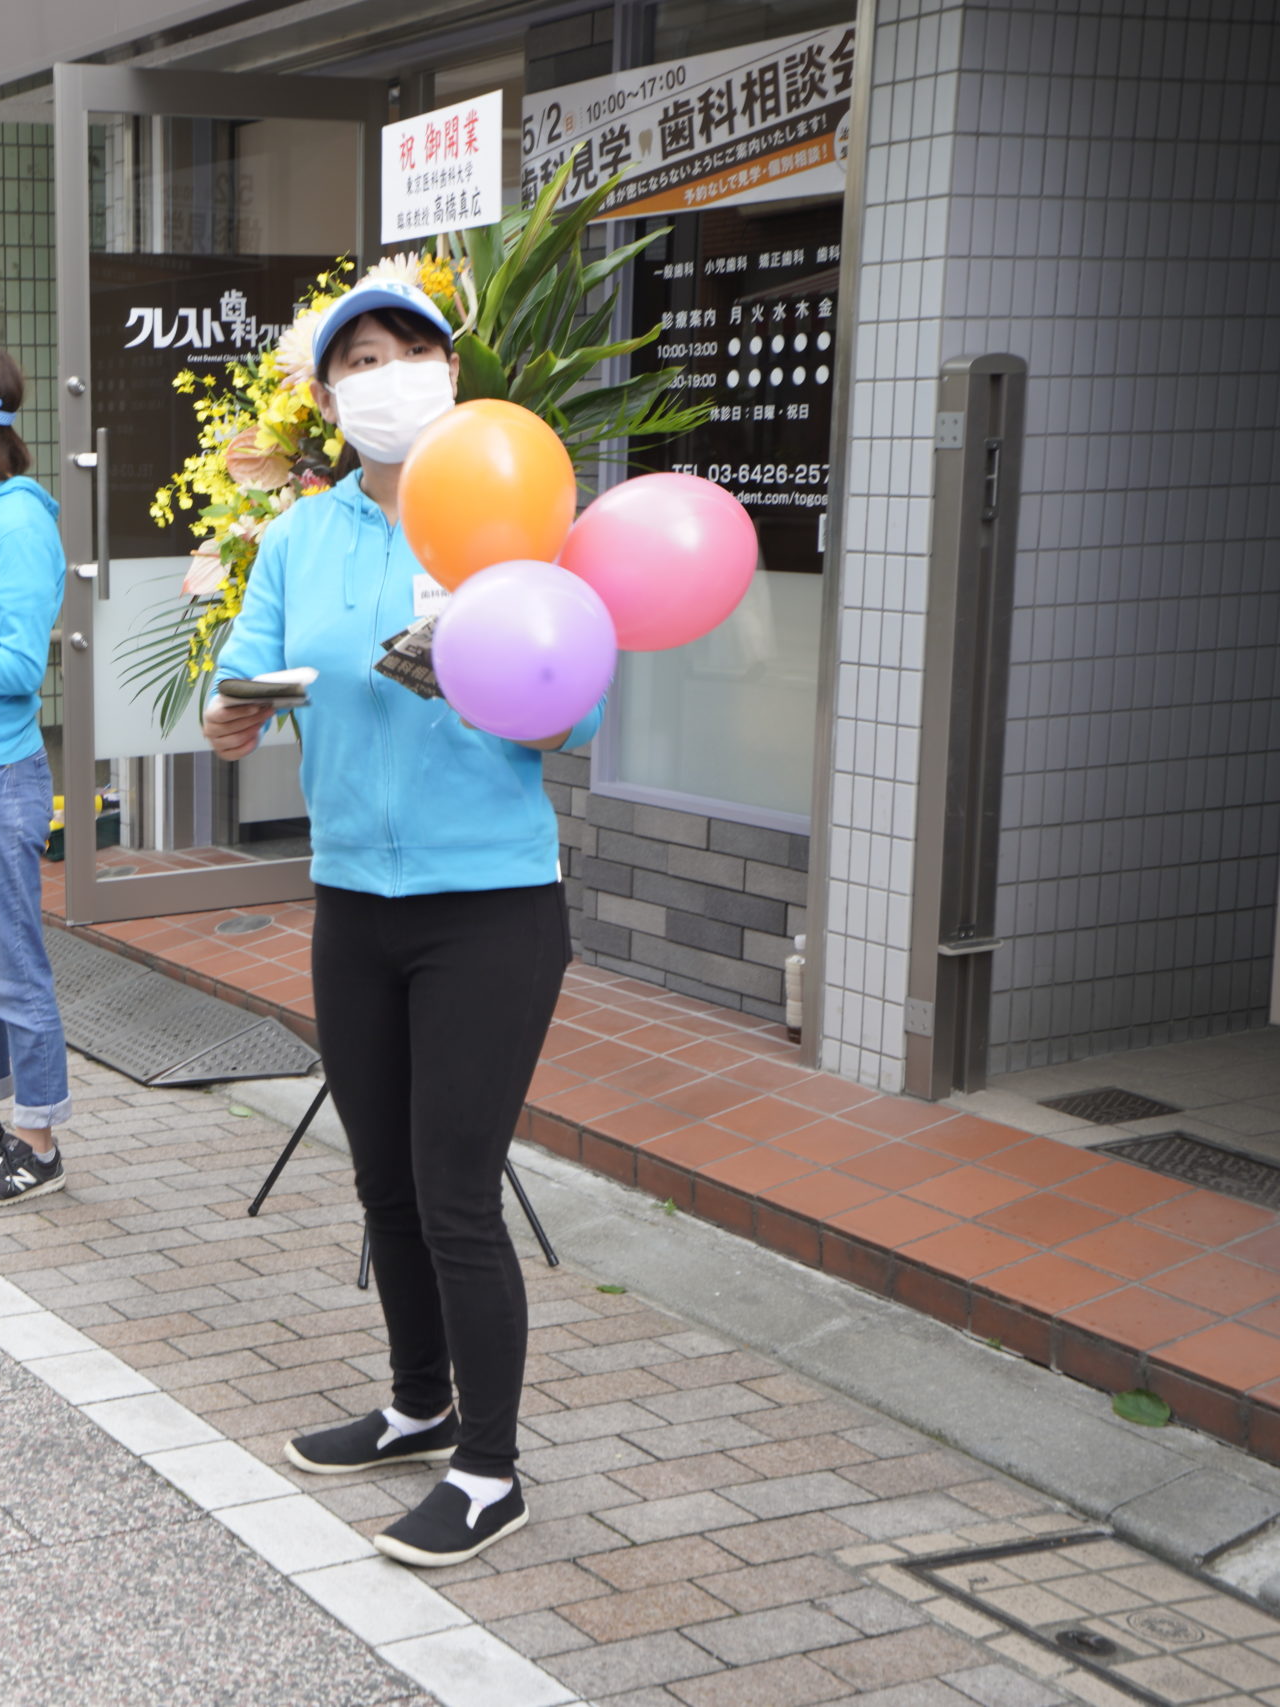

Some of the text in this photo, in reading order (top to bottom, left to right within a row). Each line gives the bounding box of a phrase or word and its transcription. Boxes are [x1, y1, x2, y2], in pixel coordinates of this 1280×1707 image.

[400, 107, 479, 172] 祝 御開業
[705, 256, 748, 275] 小児歯科
[661, 297, 833, 330] 診療案内 月 火 水 木 金
[657, 341, 718, 358] 10:00-13:00
